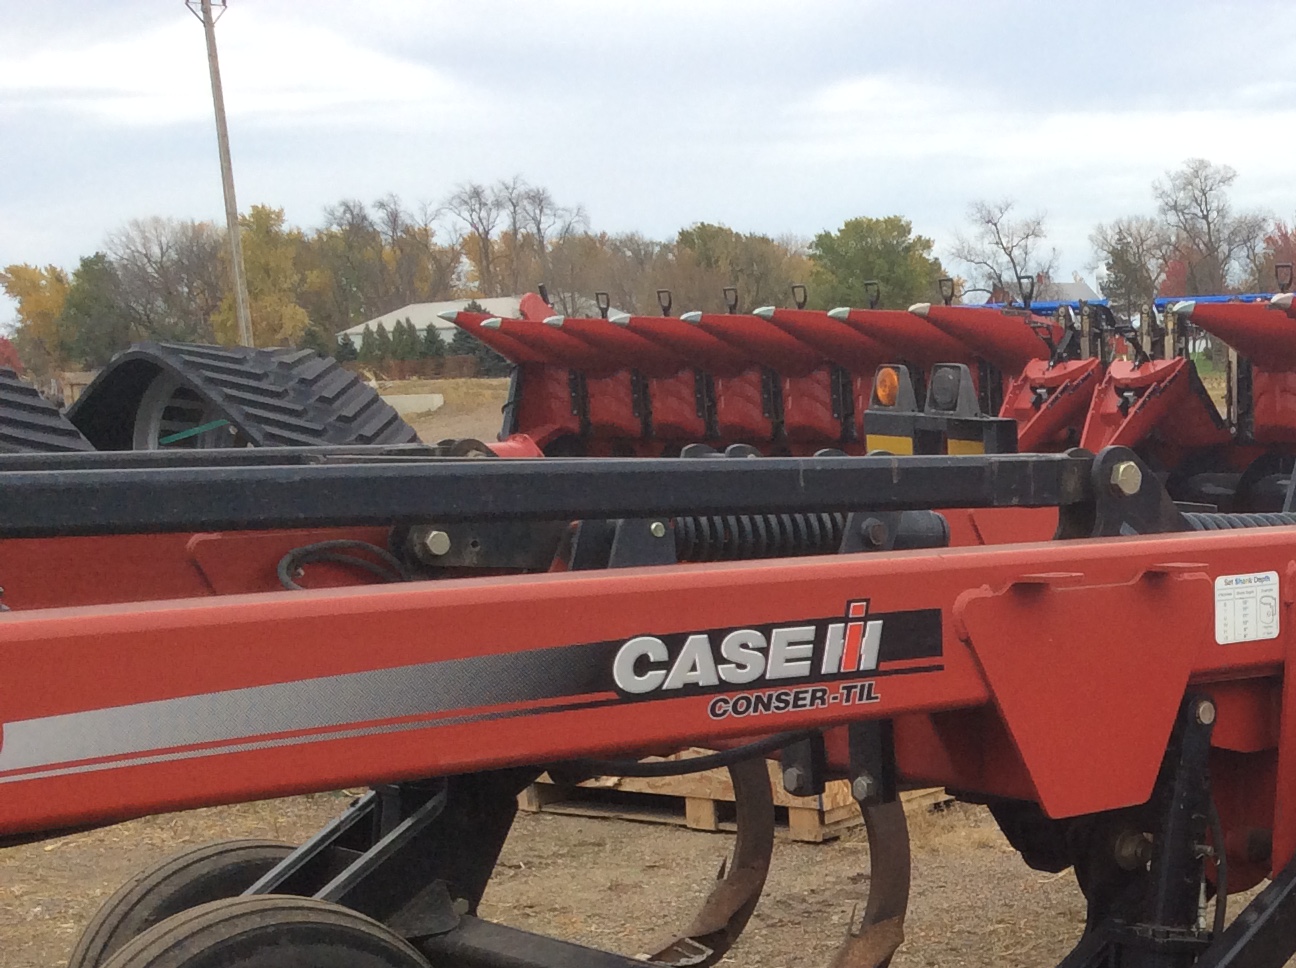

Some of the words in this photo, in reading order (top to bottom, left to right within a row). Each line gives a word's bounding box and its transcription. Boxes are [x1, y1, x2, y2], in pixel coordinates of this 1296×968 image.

[1224, 578, 1234, 586] Set
[1235, 577, 1253, 585] Shank
[1253, 575, 1271, 584] Depth
[613, 625, 816, 694] CASE
[707, 680, 881, 720] CONSER-TIL
